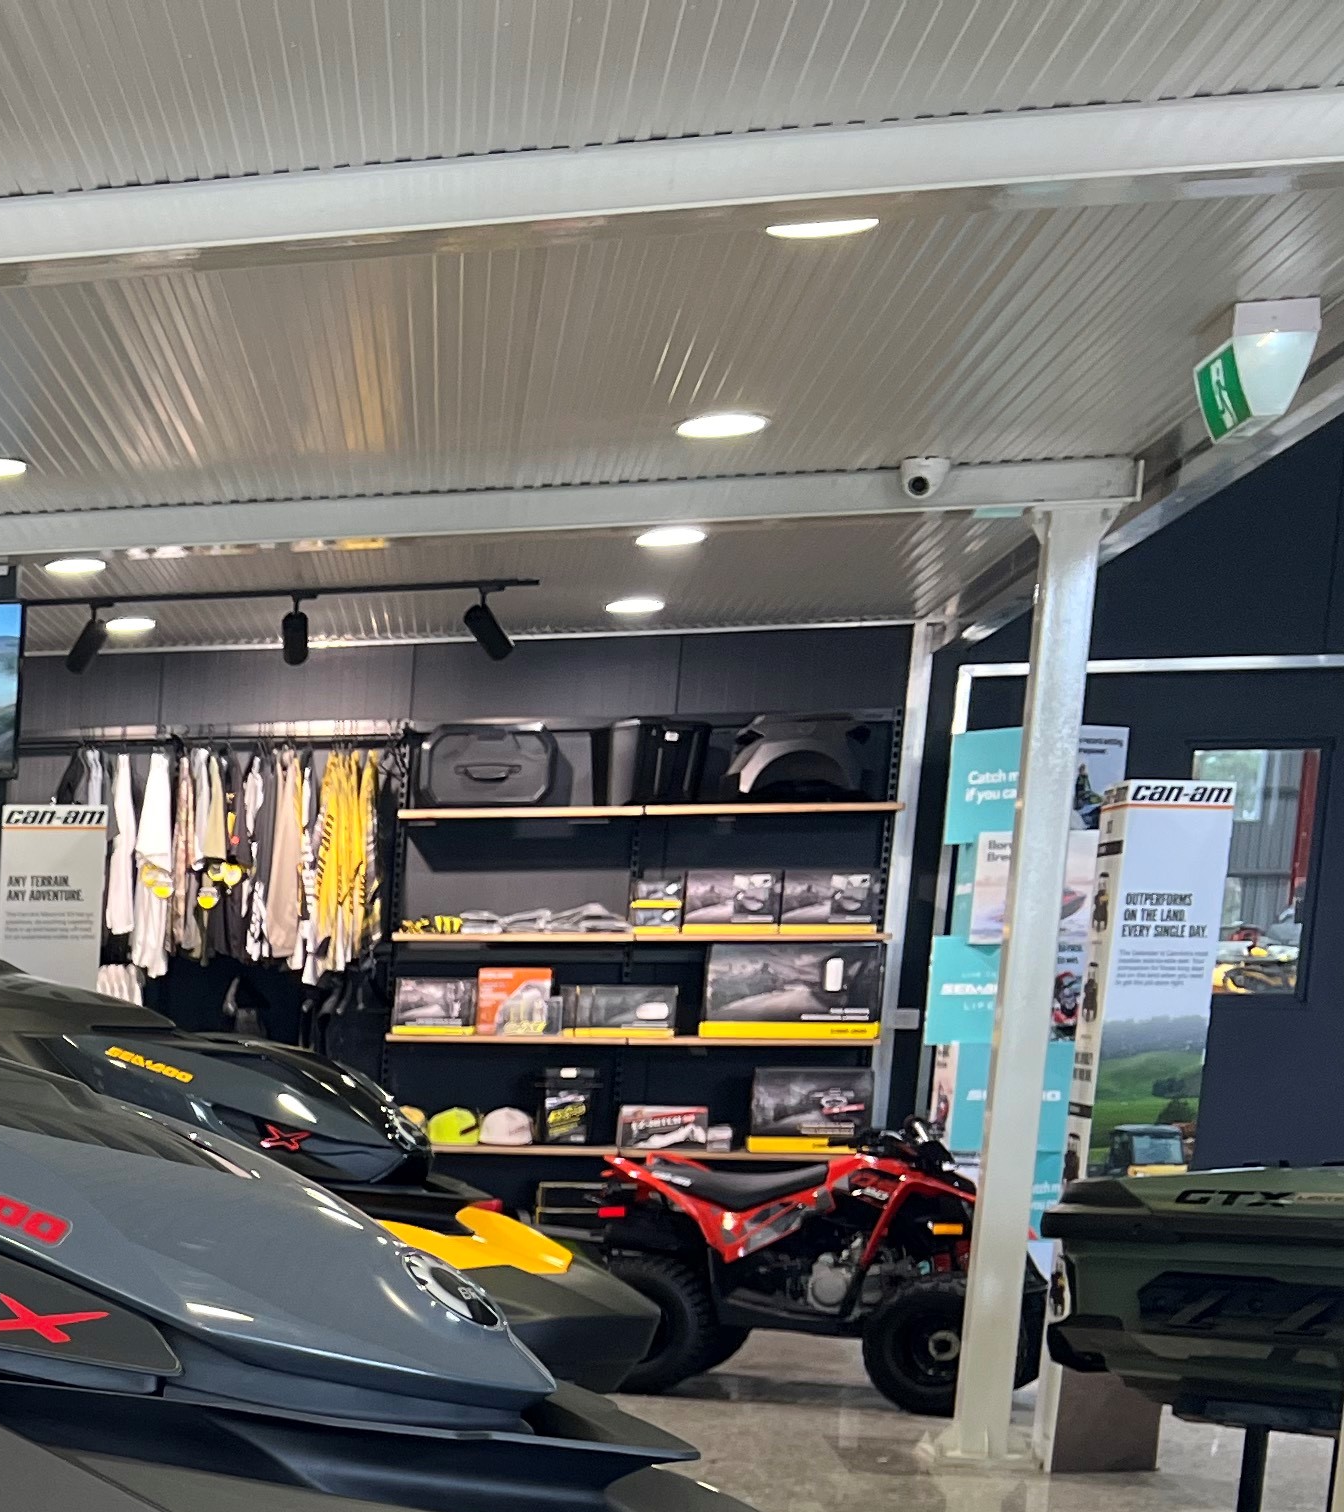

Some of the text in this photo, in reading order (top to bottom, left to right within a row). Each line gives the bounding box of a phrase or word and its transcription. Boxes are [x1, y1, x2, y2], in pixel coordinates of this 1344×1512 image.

[967, 769, 1006, 785] Catch
[976, 790, 1001, 805] you
[1002, 788, 1017, 799] ca
[1131, 784, 1234, 804] can-am
[5, 810, 105, 825] can-am
[7, 875, 27, 887] ANY
[6, 889, 26, 901] ANY
[1125, 892, 1192, 907] OUTPERFORMS
[1123, 908, 1138, 922] ON
[1140, 908, 1158, 922] THE
[1121, 924, 1151, 938] EVERY
[1153, 924, 1186, 938] SINGLE
[1174, 1189, 1296, 1208] GTX
